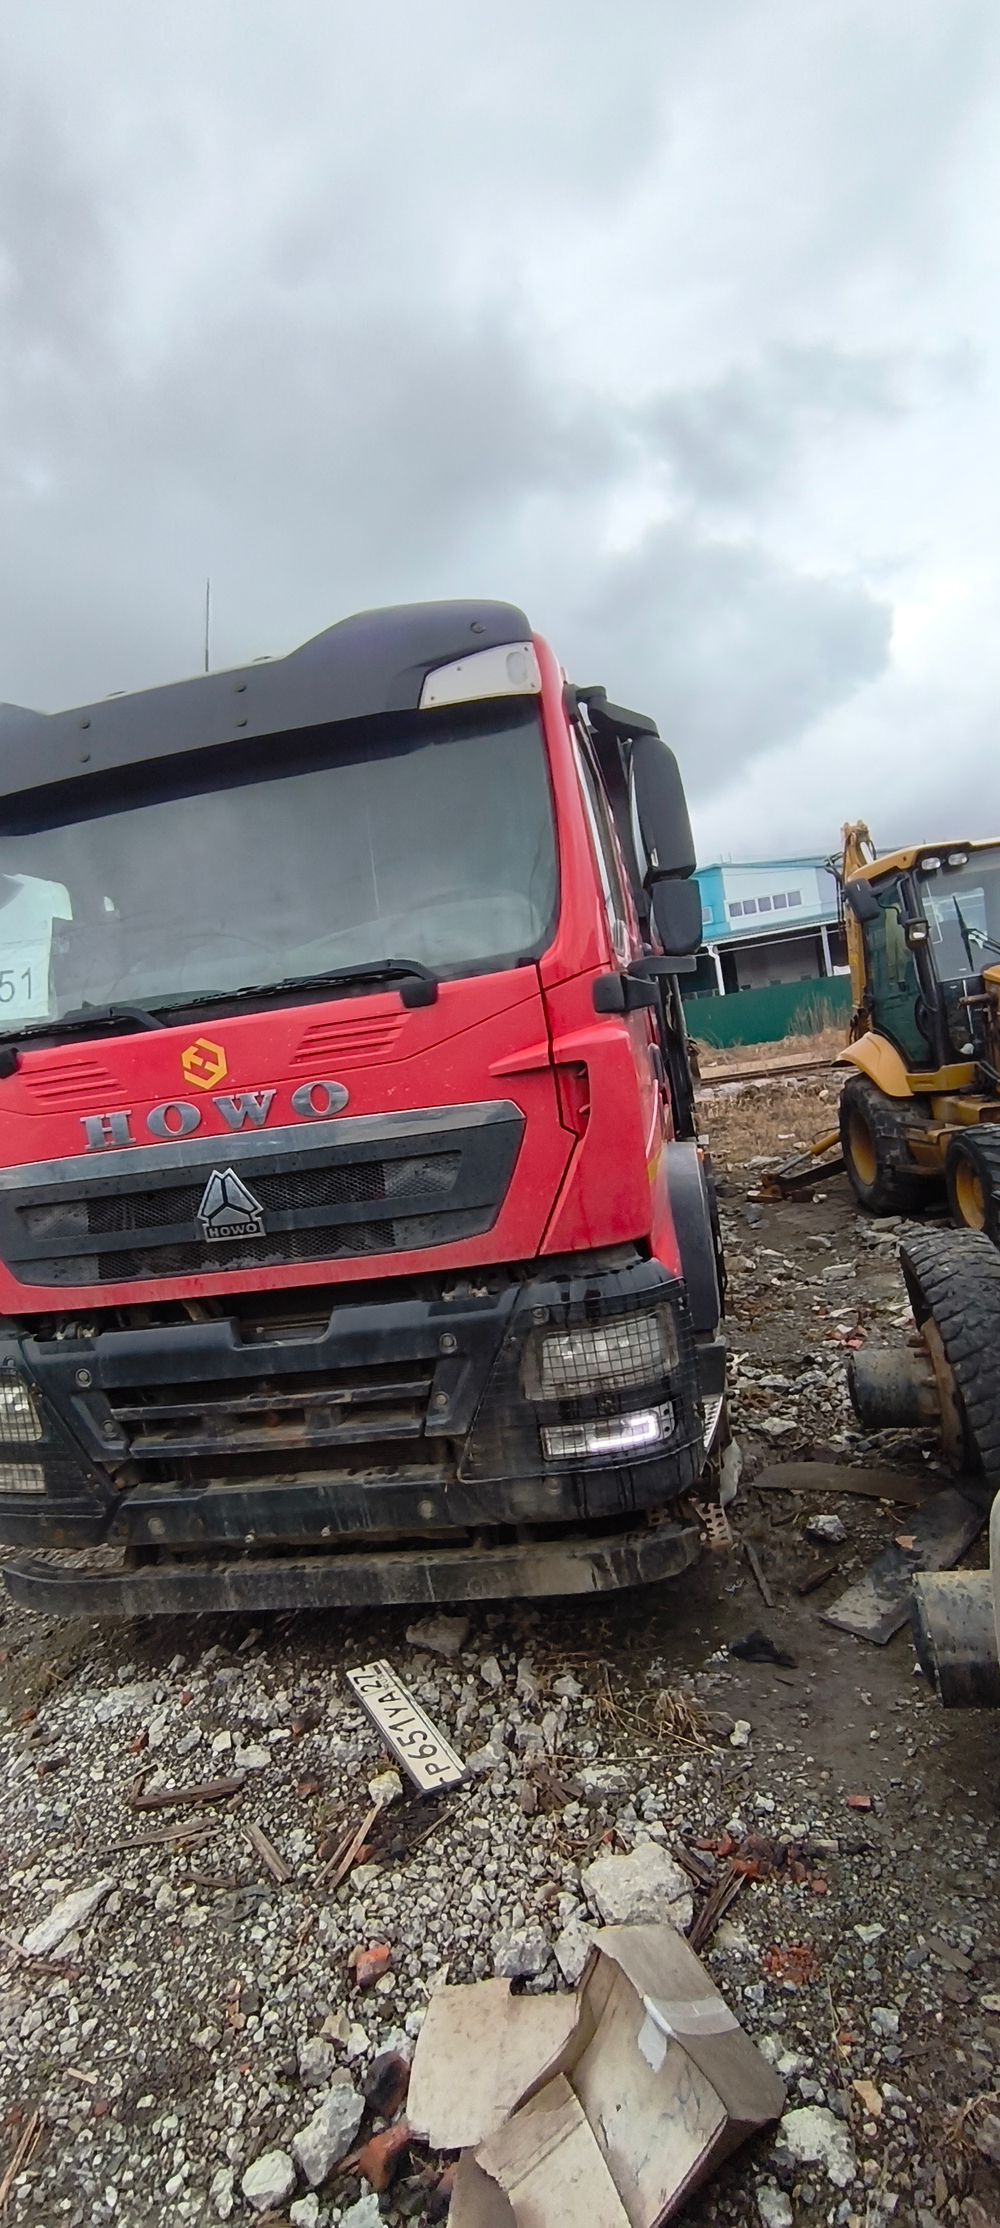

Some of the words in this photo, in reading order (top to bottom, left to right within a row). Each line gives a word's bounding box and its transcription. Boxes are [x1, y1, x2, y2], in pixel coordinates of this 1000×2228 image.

[0, 967, 32, 1003] 51
[80, 1080, 349, 1150] HOWO
[208, 1222, 259, 1239] HOWO
